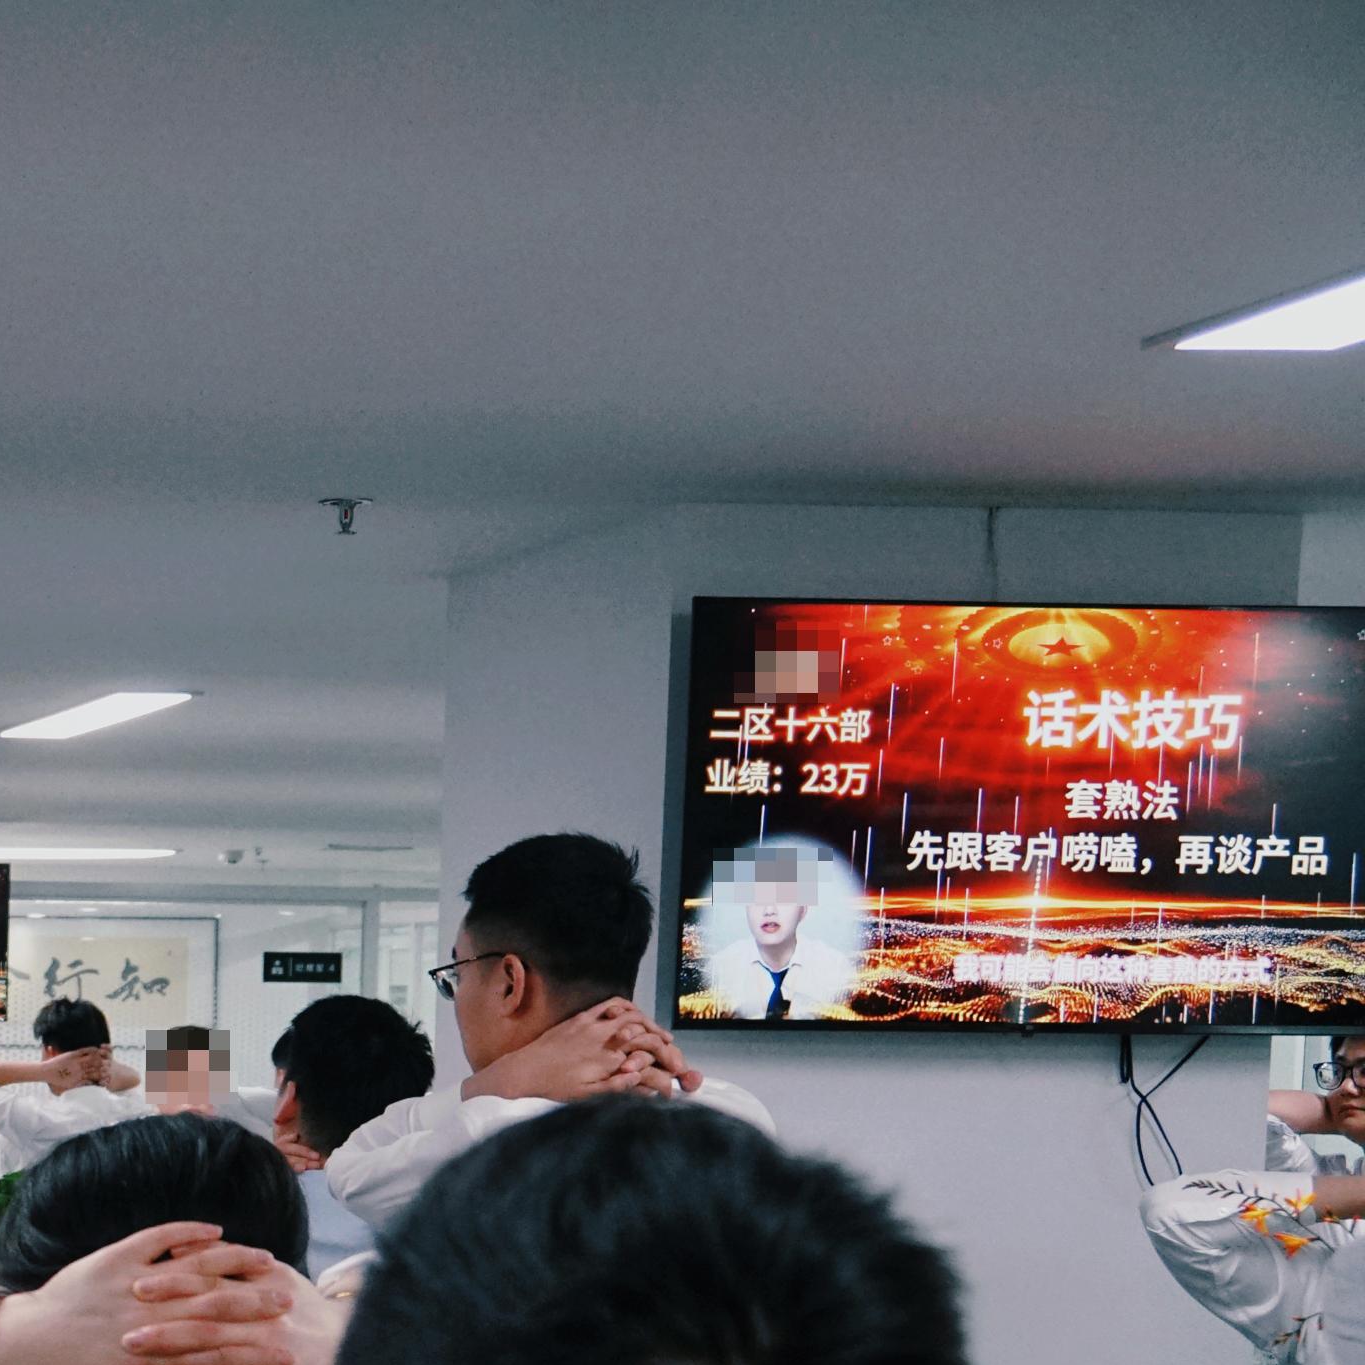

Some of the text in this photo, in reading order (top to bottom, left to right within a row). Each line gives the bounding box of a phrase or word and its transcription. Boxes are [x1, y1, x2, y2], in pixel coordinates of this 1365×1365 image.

[709, 707, 872, 743] 二区十六部
[1023, 689, 1242, 749] 话术技巧
[704, 758, 871, 796] 业绩：23万
[1065, 780, 1179, 820] 套熟法
[907, 830, 1328, 877] 先跟客户唠嗑，再谈产品
